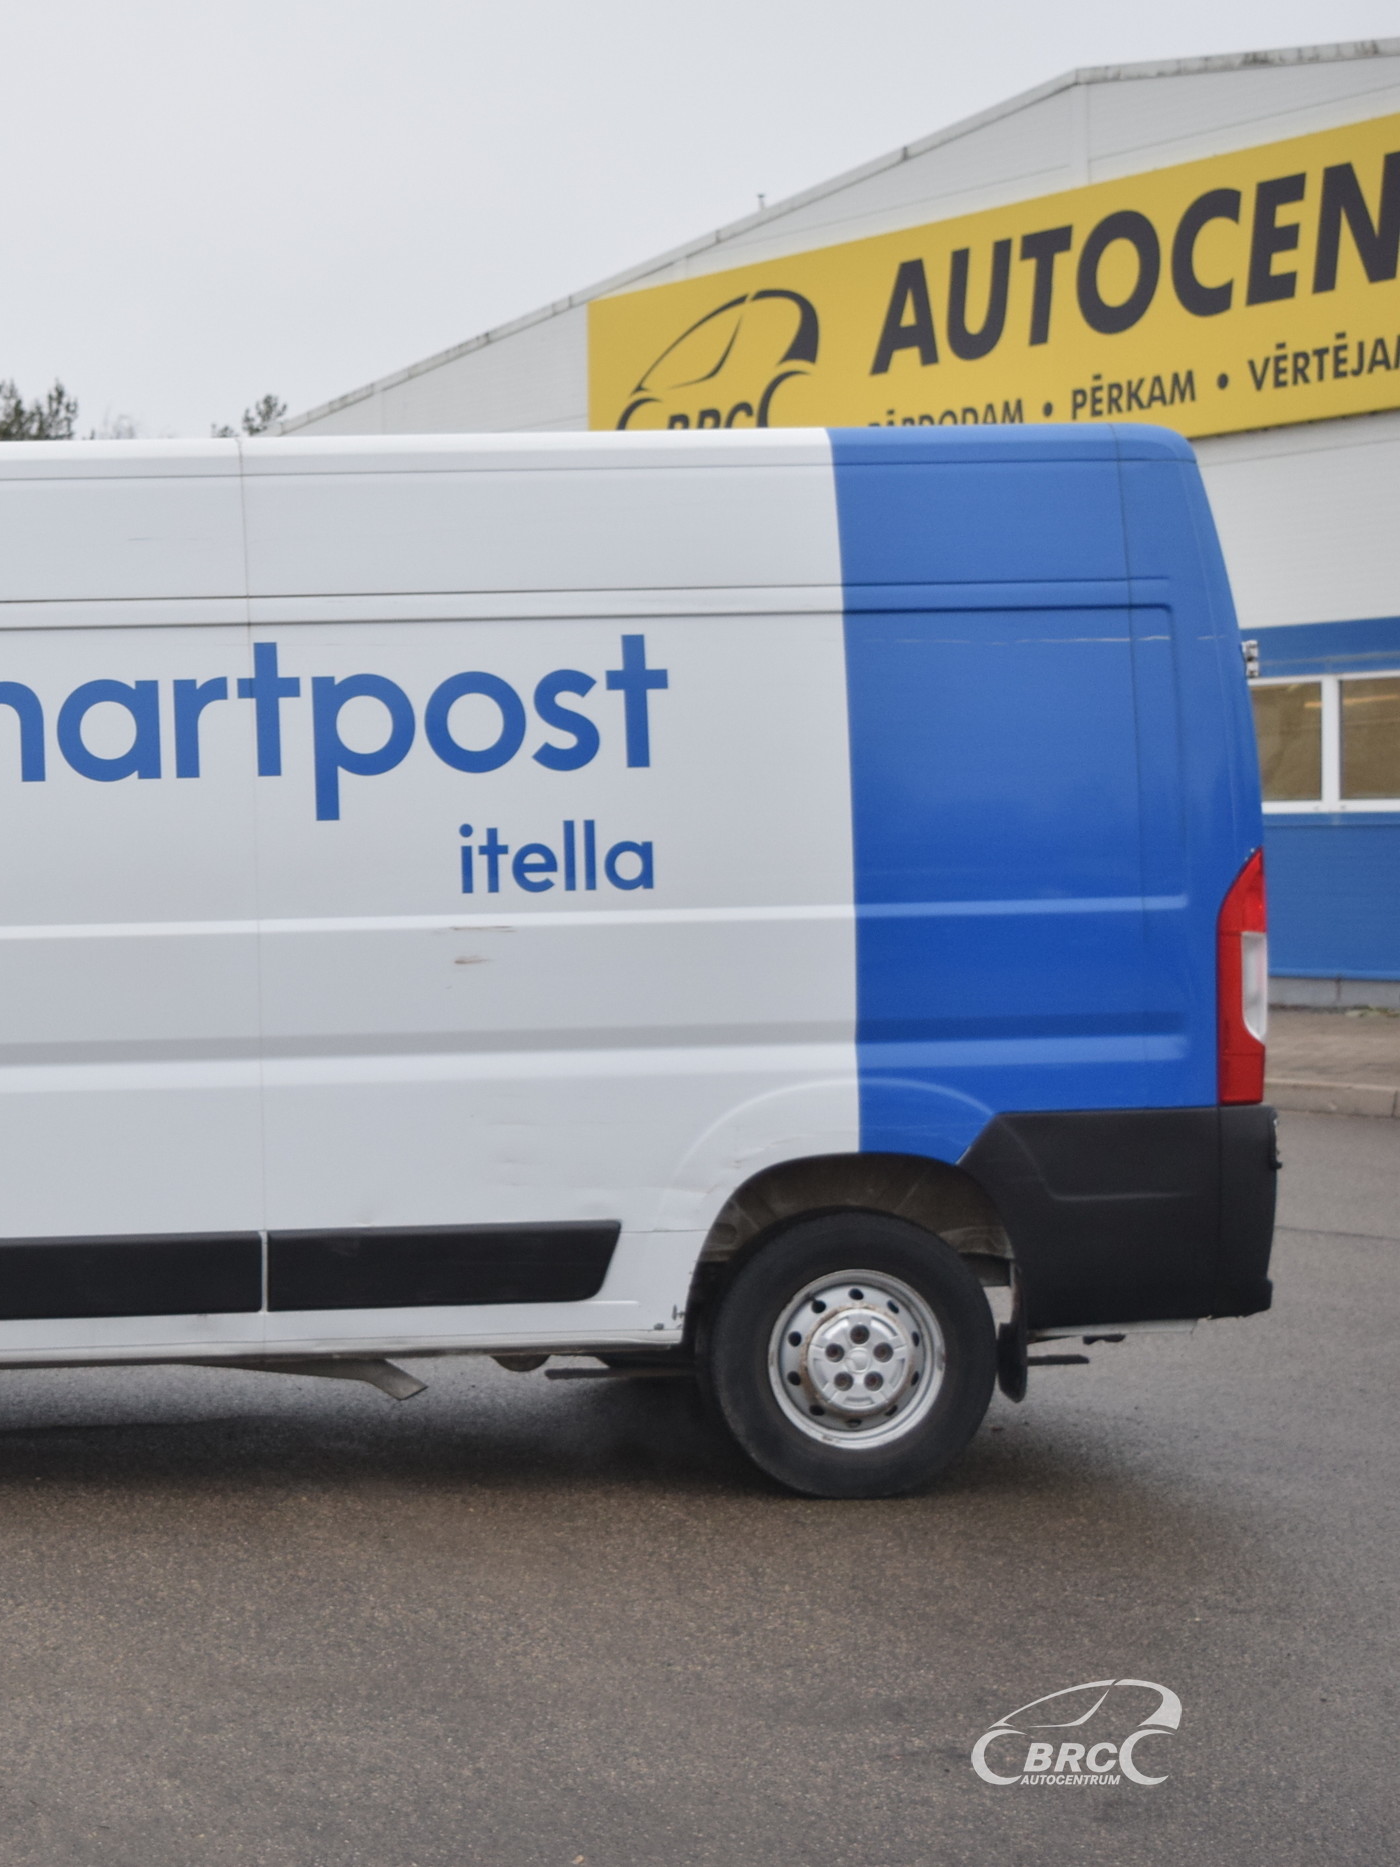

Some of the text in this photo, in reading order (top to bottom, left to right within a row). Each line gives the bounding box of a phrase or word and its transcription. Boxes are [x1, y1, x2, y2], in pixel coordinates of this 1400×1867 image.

[869, 151, 1400, 377] AUTOCEN
[1071, 370, 1196, 421] PĒRKAM
[1247, 331, 1400, 392] VĒRTĒJA
[459, 819, 655, 894] itella
